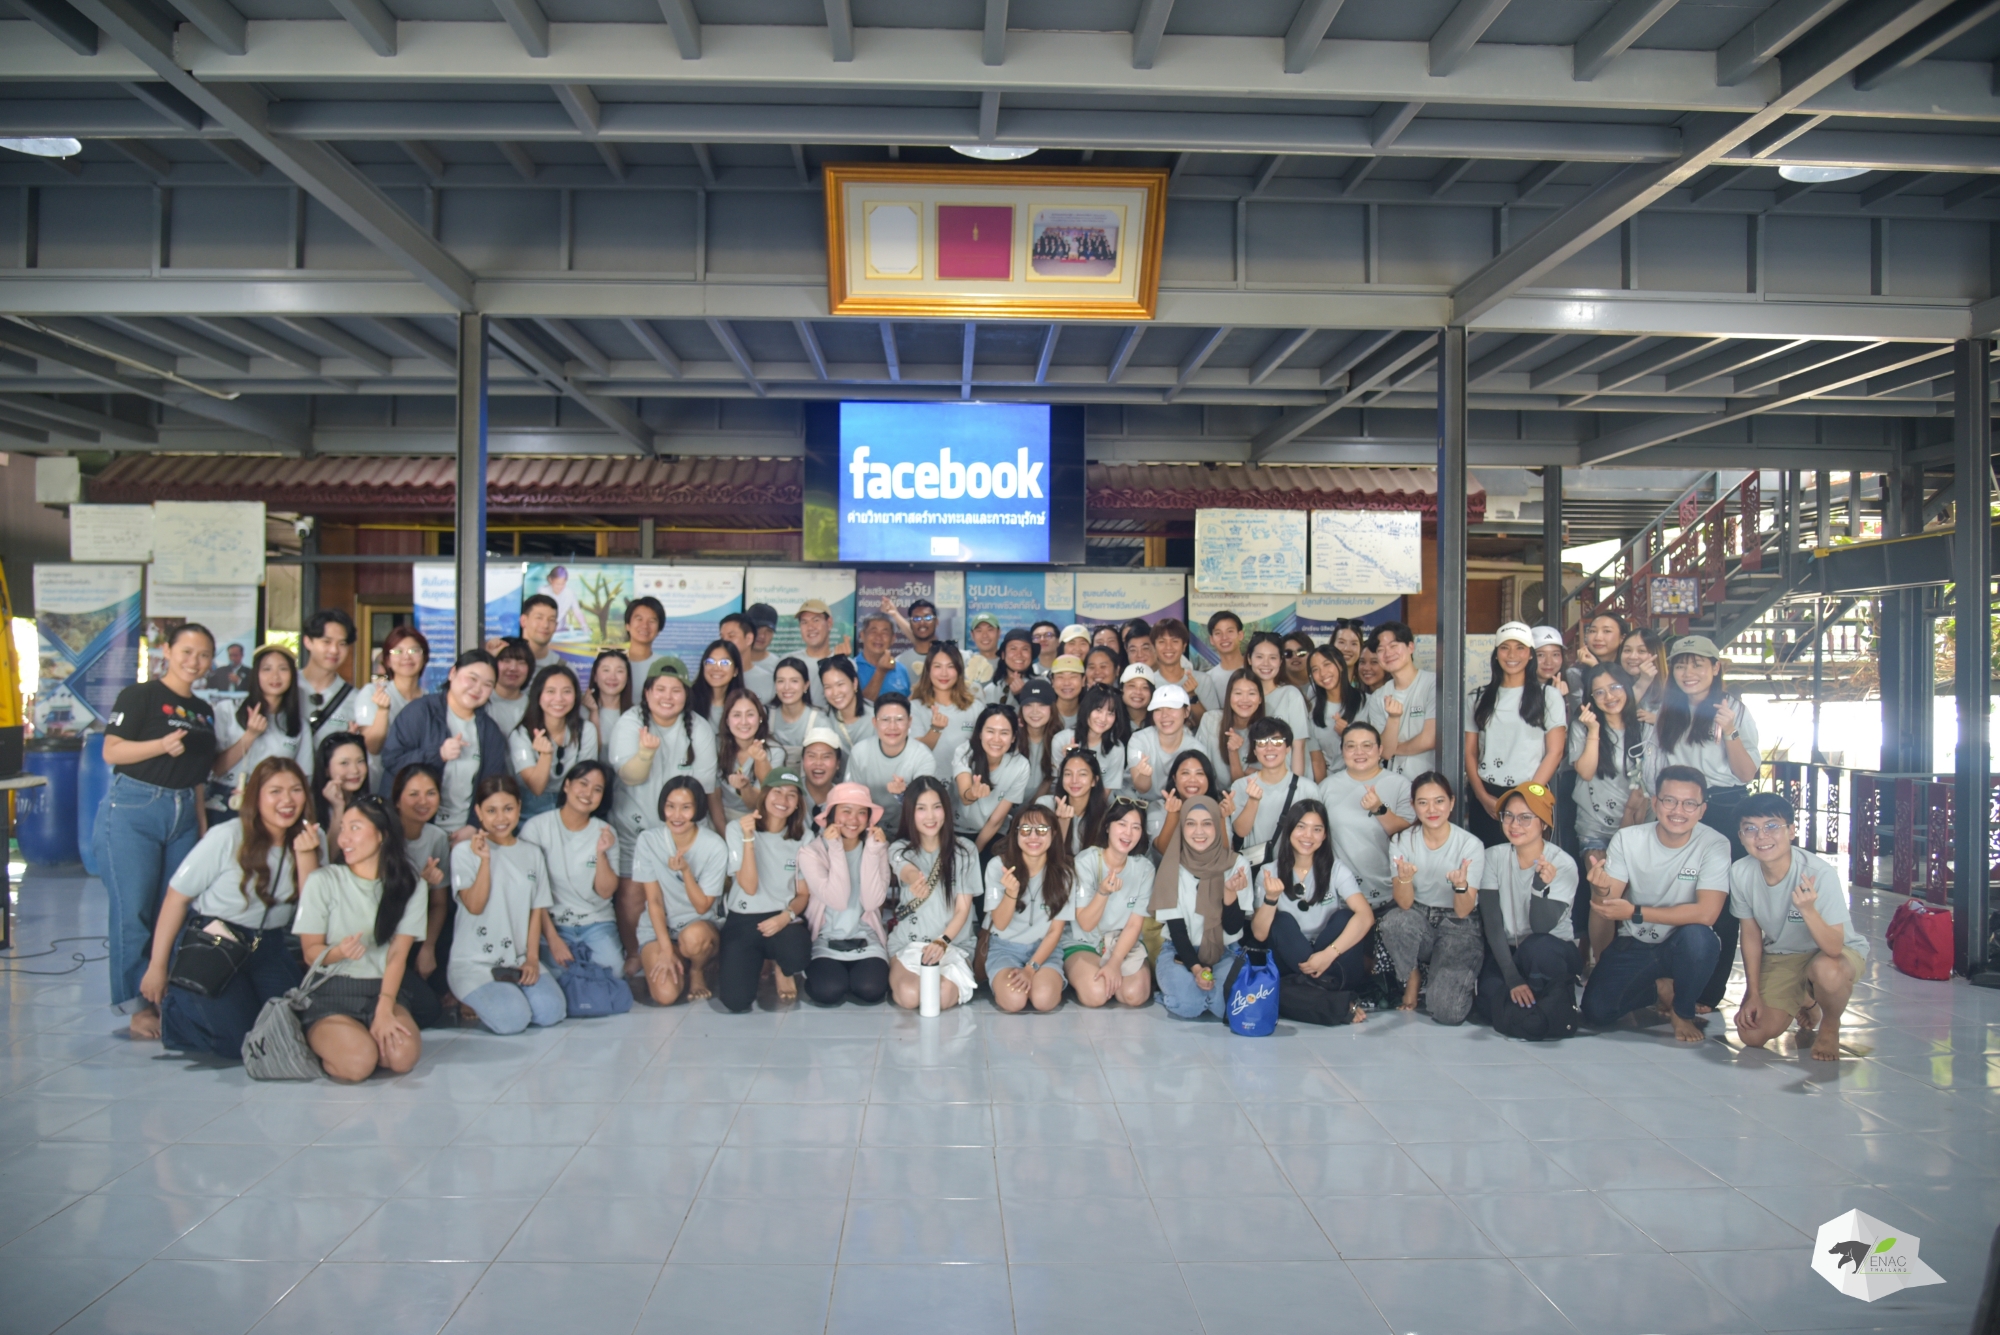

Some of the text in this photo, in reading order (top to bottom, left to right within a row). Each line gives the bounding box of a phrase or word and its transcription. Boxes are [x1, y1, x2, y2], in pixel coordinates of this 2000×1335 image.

[849, 446, 1044, 499] facebook
[847, 509, 1046, 527] ค่ายวิทยาศาสตร์ทางทะเลและการอนุรักษ์
[1680, 868, 1697, 876] ECO
[1231, 984, 1275, 1016] Agoda
